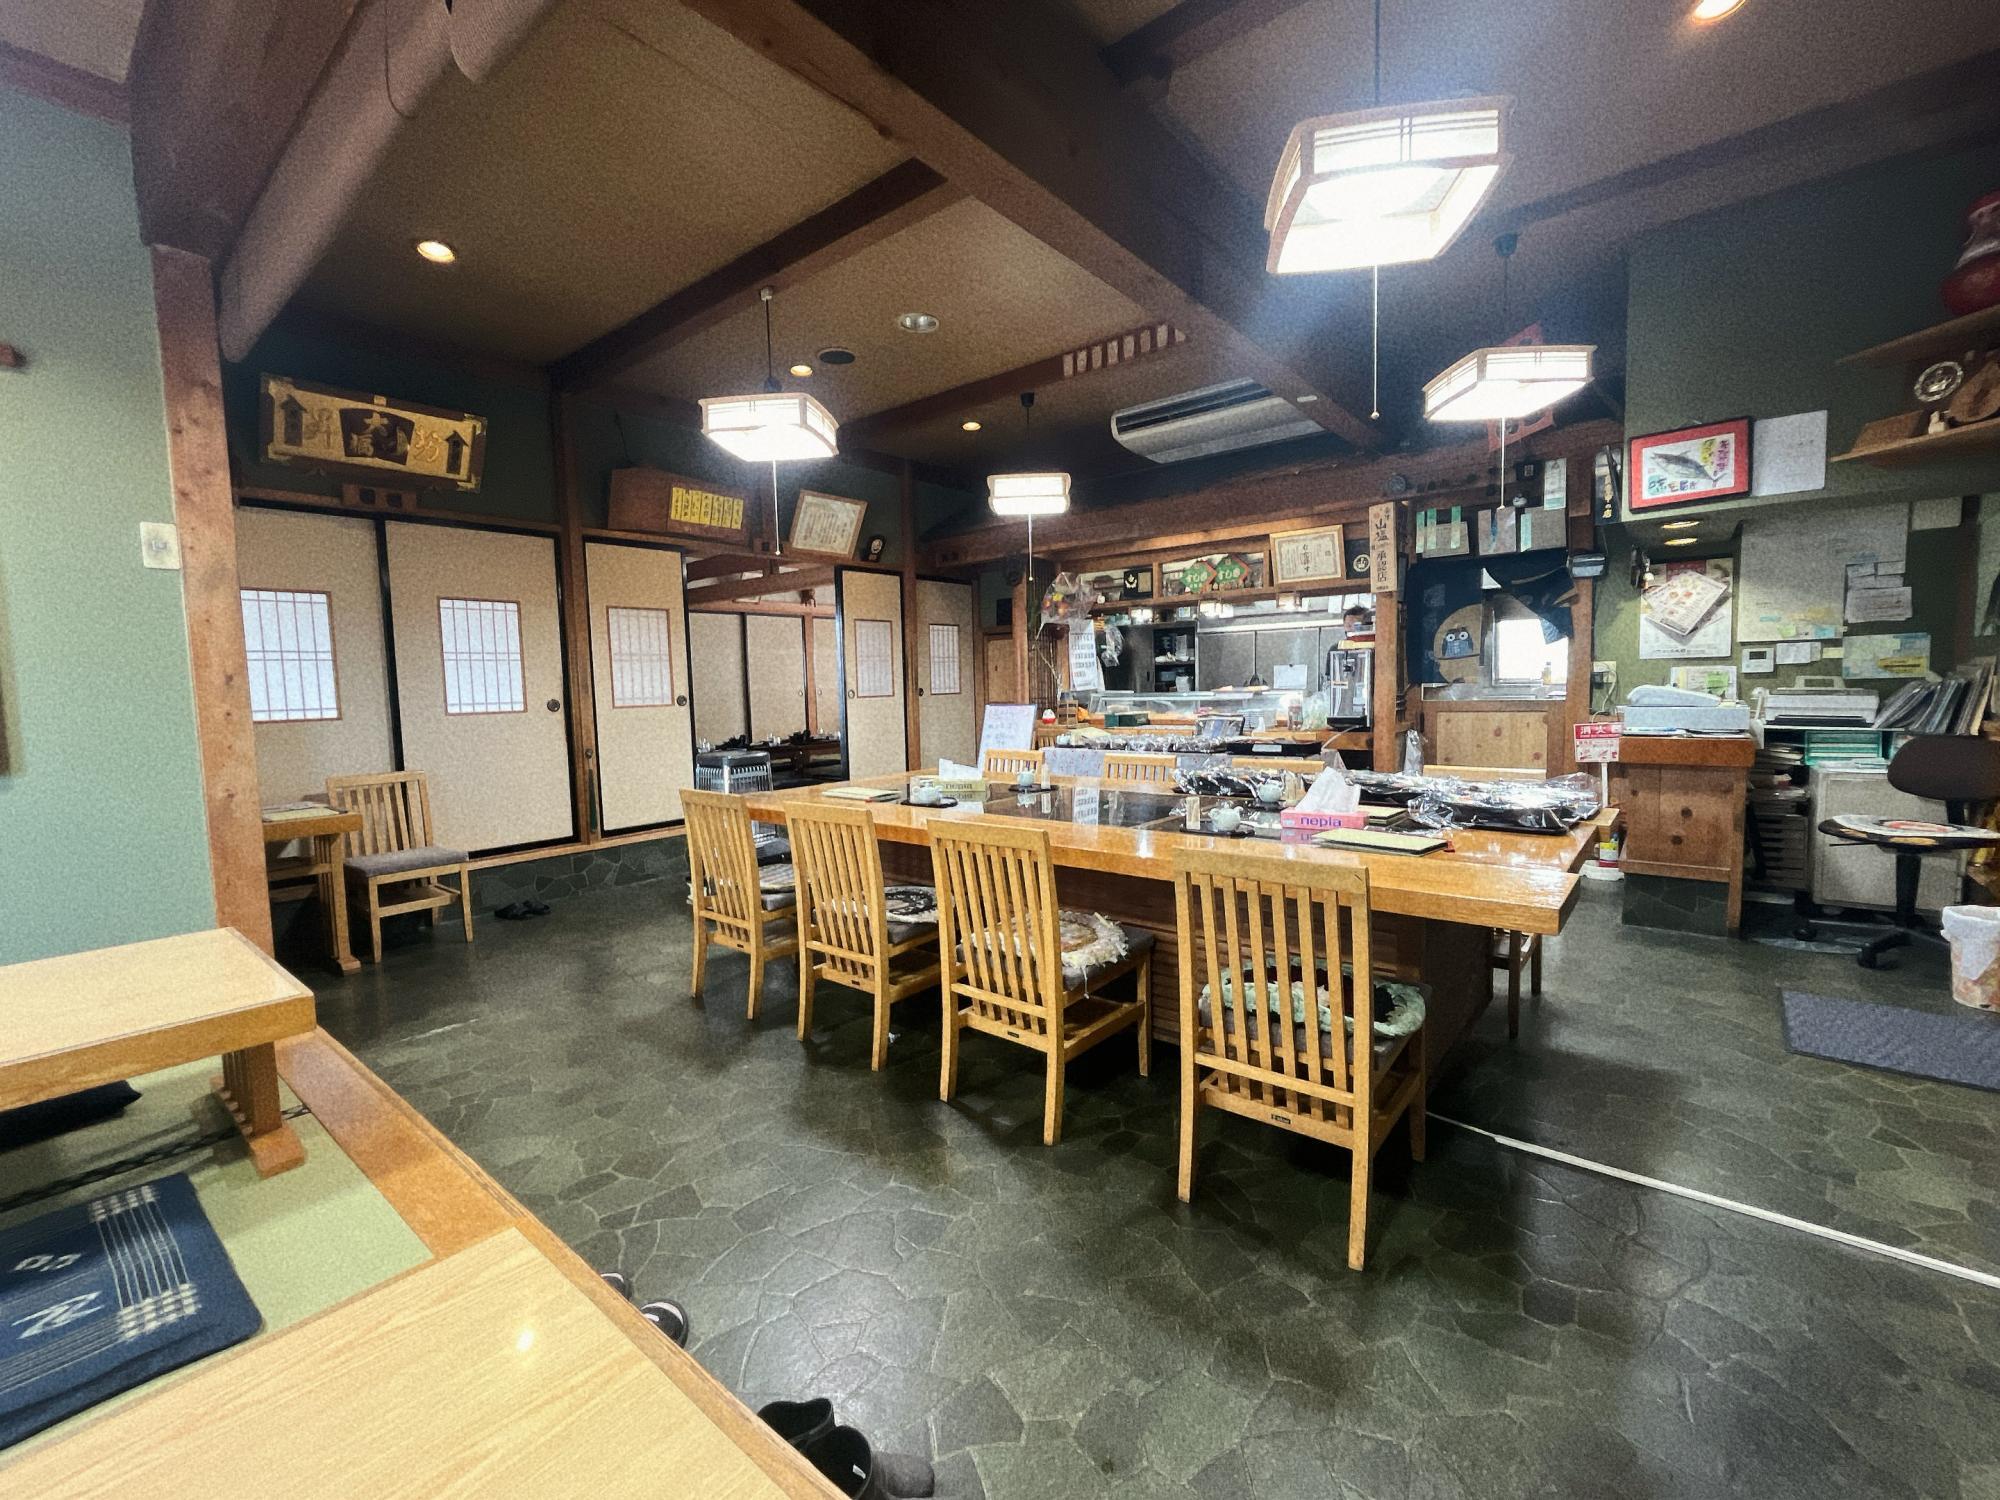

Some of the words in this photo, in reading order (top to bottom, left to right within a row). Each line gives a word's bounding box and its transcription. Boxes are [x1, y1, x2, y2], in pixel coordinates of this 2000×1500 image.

[1376, 550, 1387, 582] 承認店
[1300, 816, 1342, 827] nepia
